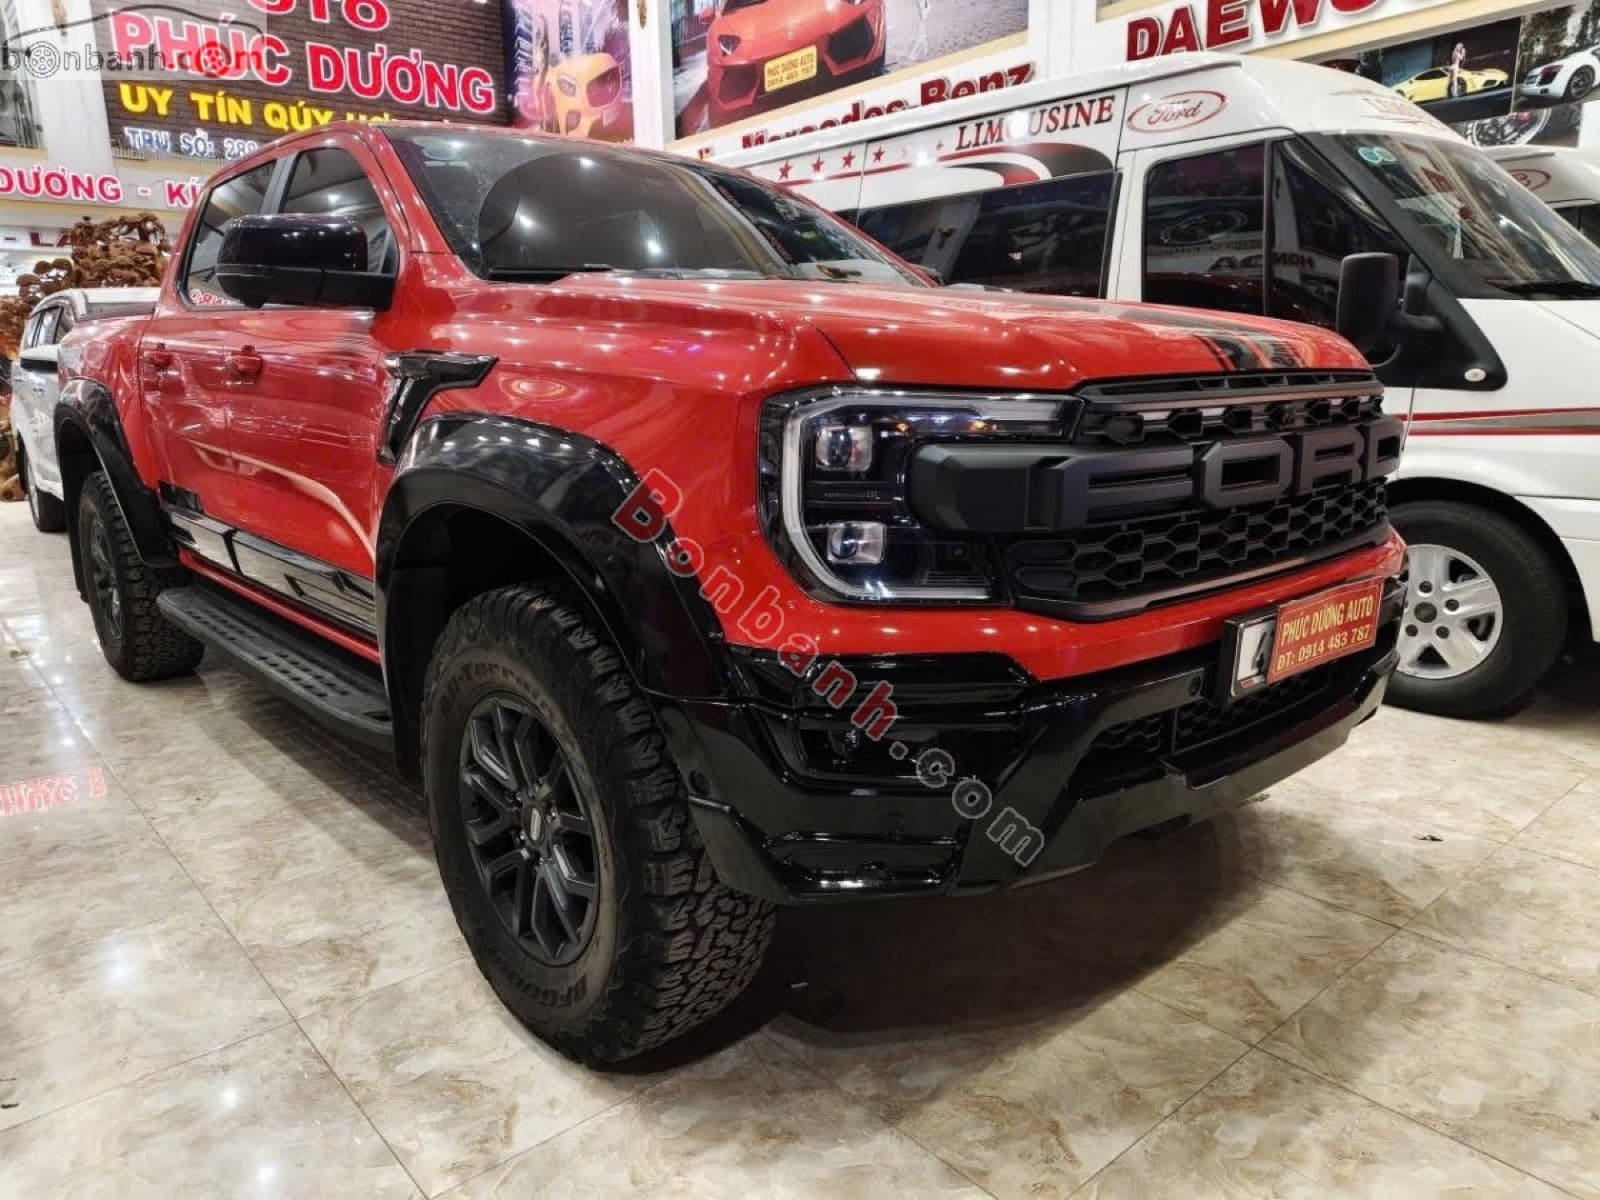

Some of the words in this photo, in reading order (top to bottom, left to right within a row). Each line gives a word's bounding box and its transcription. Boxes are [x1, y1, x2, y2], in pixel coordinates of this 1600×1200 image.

[306, 43, 496, 114] DƯƠNG
[119, 83, 174, 117] UY
[190, 91, 253, 126] TÍN
[955, 95, 1116, 151] LIMUSINE
[1147, 98, 1204, 126] Ford
[1346, 595, 1374, 622] AUTO
[1298, 639, 1325, 662] 0914
[1327, 631, 1348, 650] 483
[1351, 623, 1371, 644] 787
